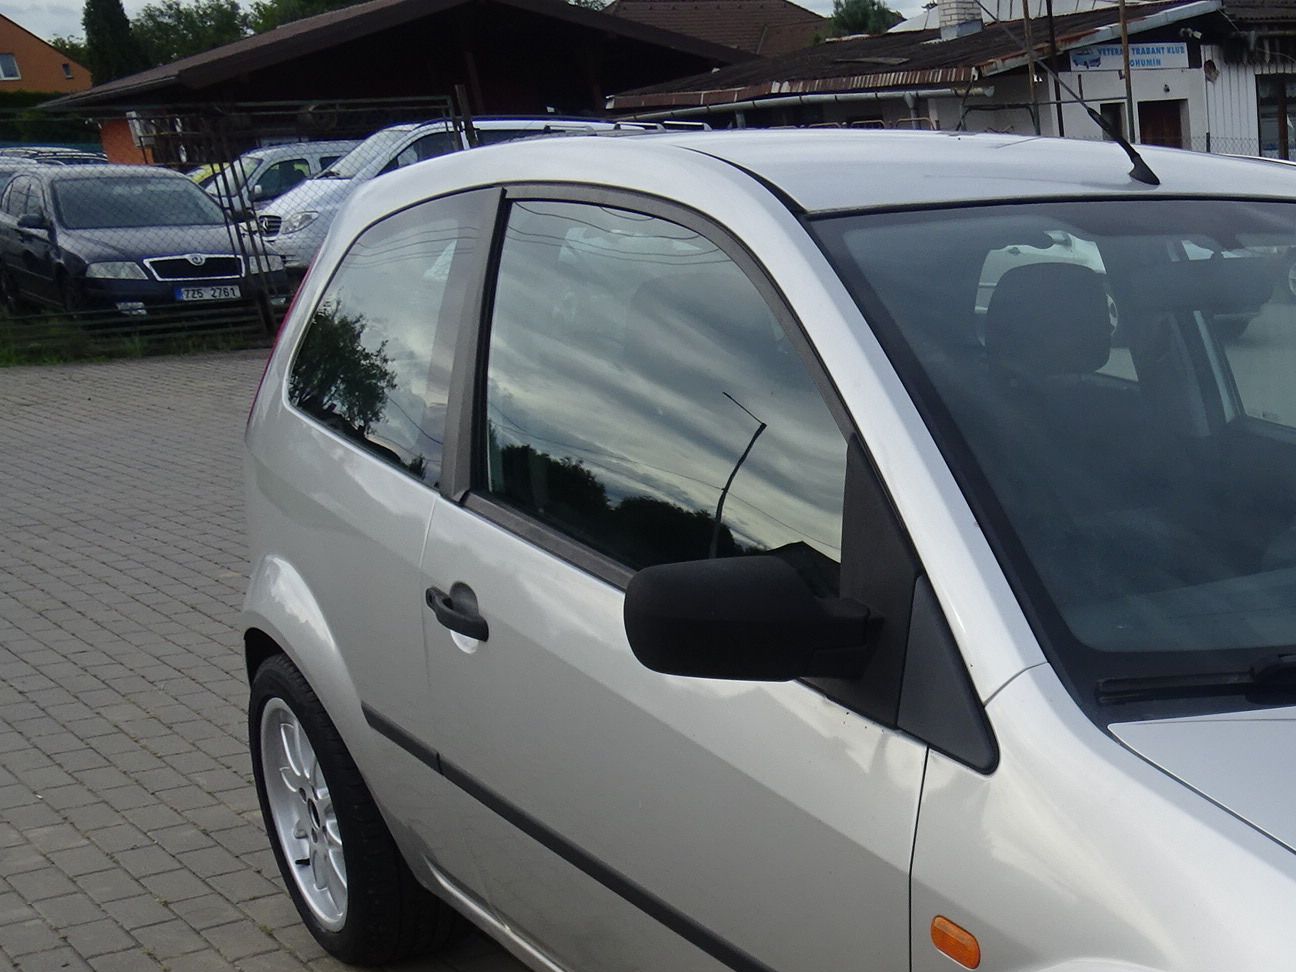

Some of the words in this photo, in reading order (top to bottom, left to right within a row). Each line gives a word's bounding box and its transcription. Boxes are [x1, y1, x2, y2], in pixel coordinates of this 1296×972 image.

[1097, 47, 1124, 56] VETERA
[1131, 47, 1165, 56] TRABANT
[1167, 46, 1185, 54] KLUB
